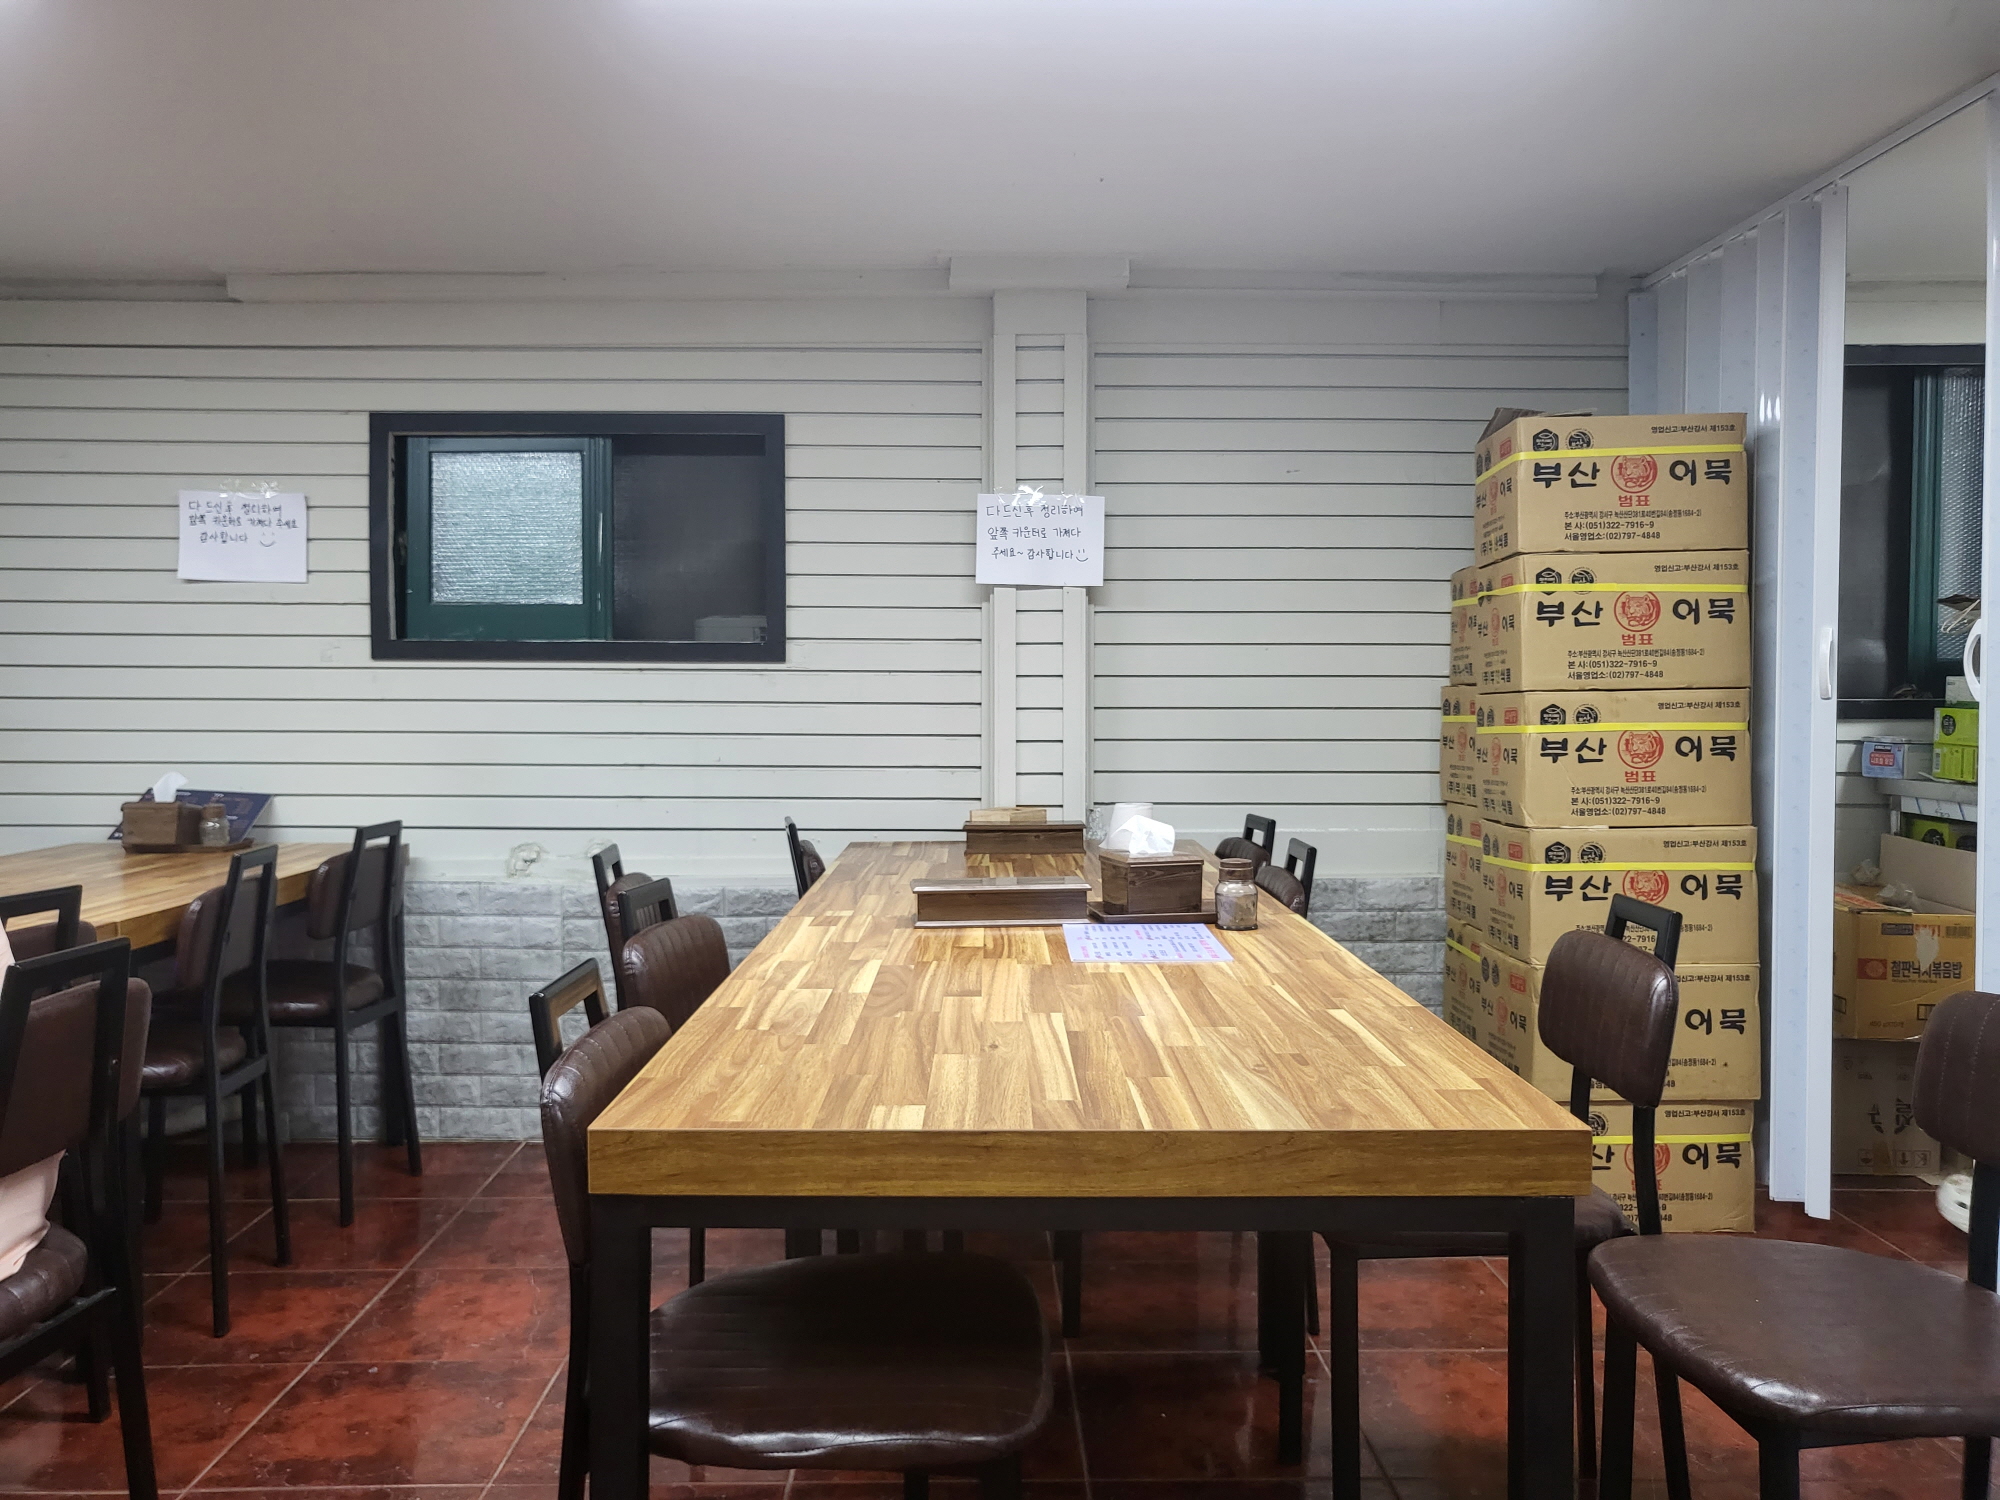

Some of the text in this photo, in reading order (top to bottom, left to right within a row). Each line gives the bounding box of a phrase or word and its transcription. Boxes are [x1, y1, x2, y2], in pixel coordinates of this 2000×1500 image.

[1651, 424, 1736, 434] 영업신고:부산강서 제153호
[1532, 459, 1732, 488] 부산 어묵
[1618, 495, 1650, 507] 범표
[1040, 504, 1083, 518] 정리하여
[1564, 522, 1572, 530] 본
[200, 531, 248, 544] 감사합니다
[988, 526, 1081, 540] 앞쪽 카운터로 가져다
[1564, 532, 1661, 541] 서울영업소:(02)797-4848
[1027, 548, 1073, 560] 감사합니다
[1654, 564, 1711, 572] 영업신고:부산강서
[1536, 598, 1735, 627] 부산 어묵
[1621, 634, 1653, 646] 범표
[1568, 661, 1575, 669] 본
[1568, 671, 1663, 680] 서울영업소:(02)797-4848
[1658, 701, 1740, 710] 영업신고:부산강서 제153호
[1540, 735, 1737, 764] 부산 어묵
[1625, 771, 1656, 783] 범표
[1571, 797, 1579, 806] 본
[1571, 807, 1666, 817] 서울영업소:(02)797-4848
[1663, 839, 1747, 848] 영업신고:부산강서 제153호
[1544, 874, 1743, 902] 부산 어묵
[1725, 974, 1750, 982] 제153호
[1685, 1008, 1746, 1035] 어묵
[1665, 1109, 1745, 1118] 영업신고:부산강서 제153호
[1592, 1143, 1742, 1170] 산 어묵
